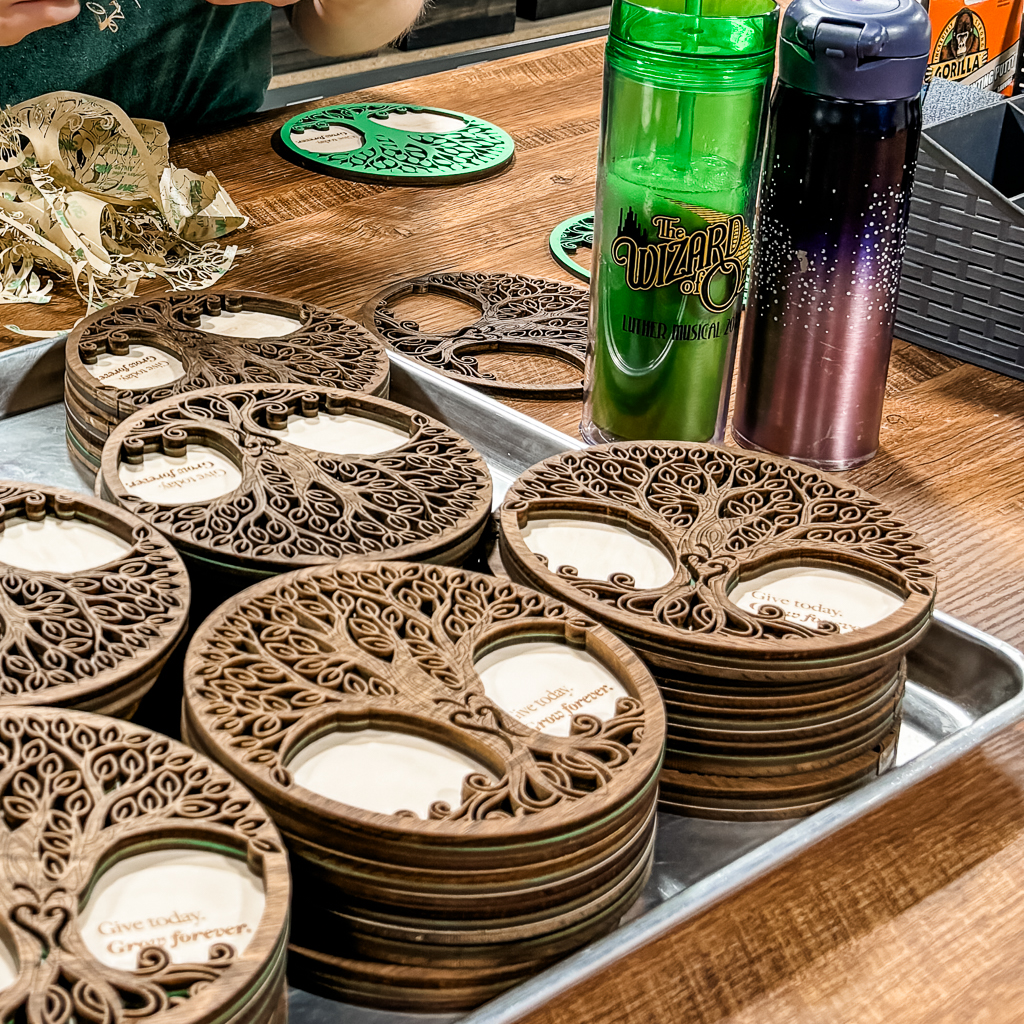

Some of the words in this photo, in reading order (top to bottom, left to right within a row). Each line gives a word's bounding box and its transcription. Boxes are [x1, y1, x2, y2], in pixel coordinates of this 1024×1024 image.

[934, 55, 981, 79] GORILLA
[650, 215, 687, 241] The
[611, 214, 746, 292] WIZARD
[679, 270, 706, 296] of
[622, 314, 668, 340] LUTHER
[671, 321, 722, 342] MUSICAL
[128, 355, 157, 368] Grow
[146, 361, 170, 371] Give
[119, 369, 148, 382] today.
[125, 468, 176, 488] forever.
[177, 460, 215, 475] Grow
[199, 469, 227, 480] Give
[159, 476, 197, 491] today.
[751, 590, 790, 605] Give
[795, 600, 844, 617] today.
[509, 703, 537, 720] ive
[534, 685, 574, 707] today.
[531, 708, 565, 732] row
[561, 684, 614, 716] forever.
[97, 920, 143, 936] Give
[147, 910, 206, 927] today.
[106, 934, 167, 955] Grow
[171, 923, 252, 949] forever.
